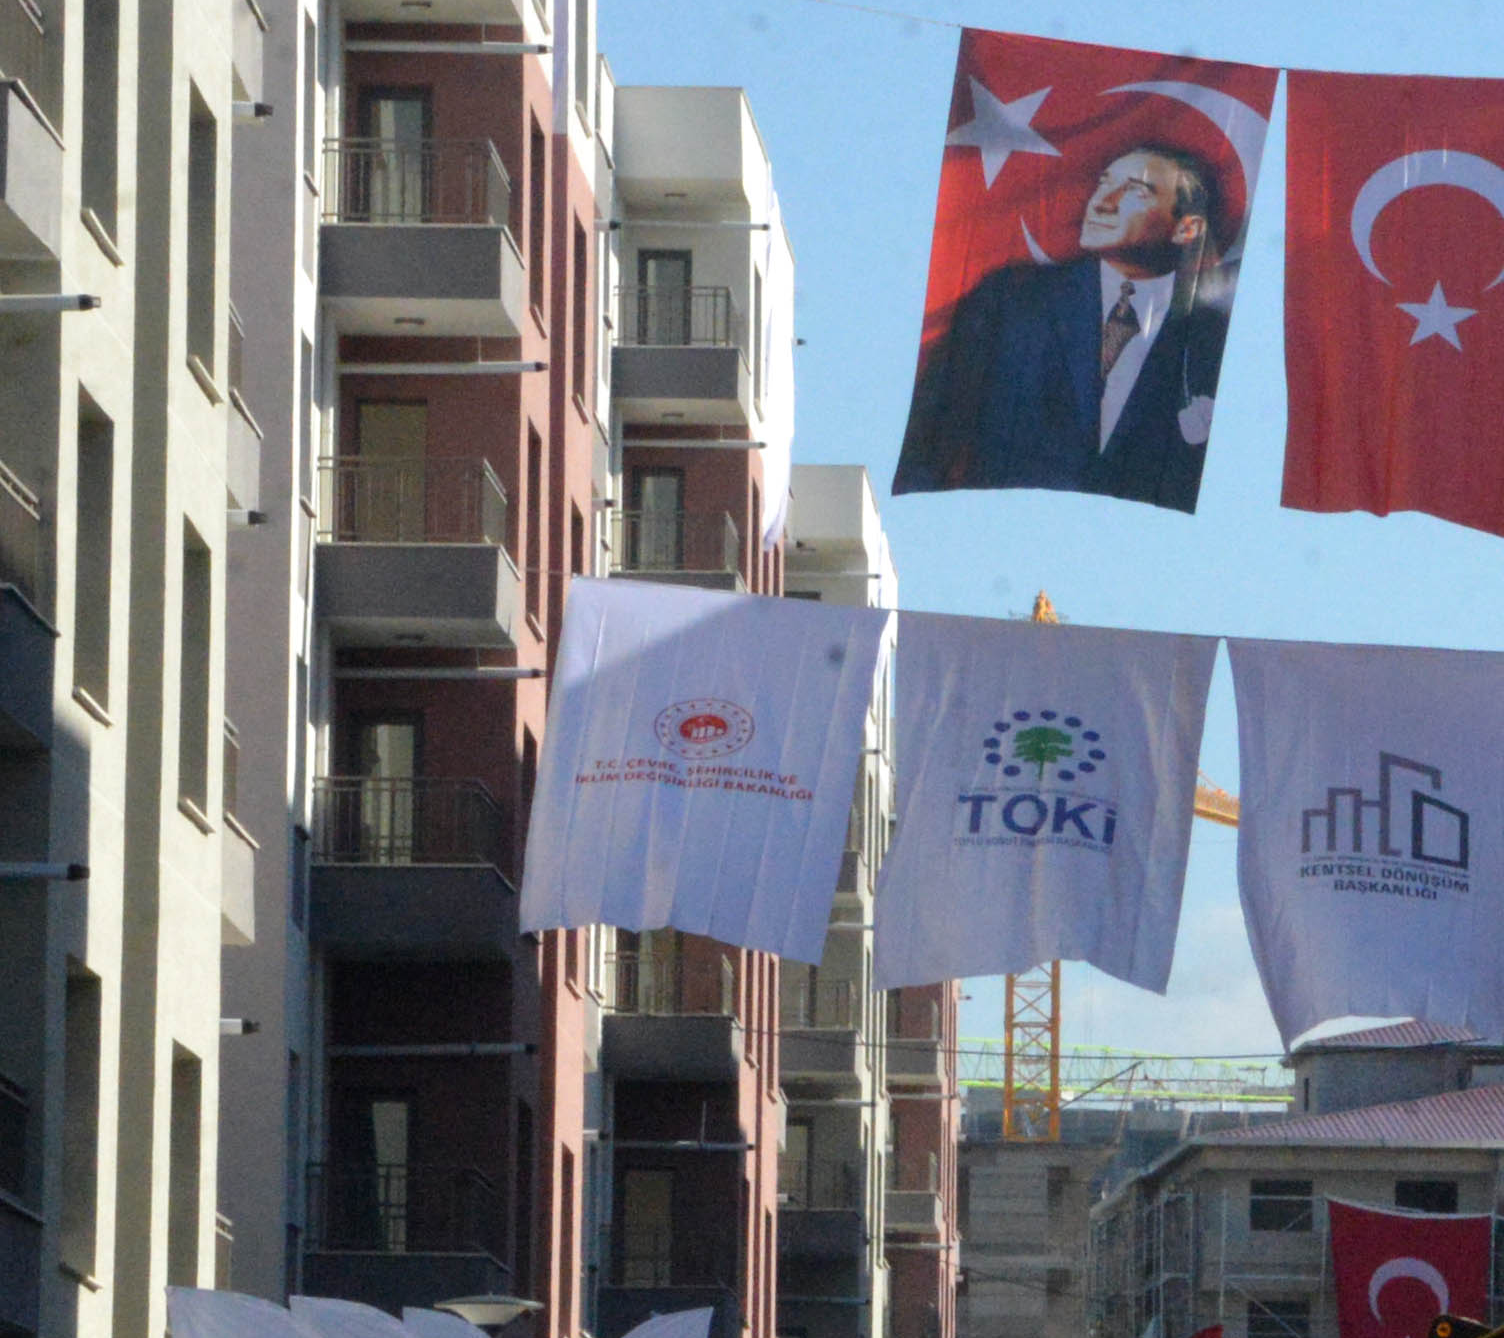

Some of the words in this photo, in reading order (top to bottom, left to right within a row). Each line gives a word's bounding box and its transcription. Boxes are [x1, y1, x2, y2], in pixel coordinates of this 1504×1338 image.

[778, 773, 798, 785] VE
[958, 794, 1117, 844] TOKİ
[1301, 864, 1376, 878] KENTSEL
[1334, 879, 1437, 900] BAŞKANLIĞI
